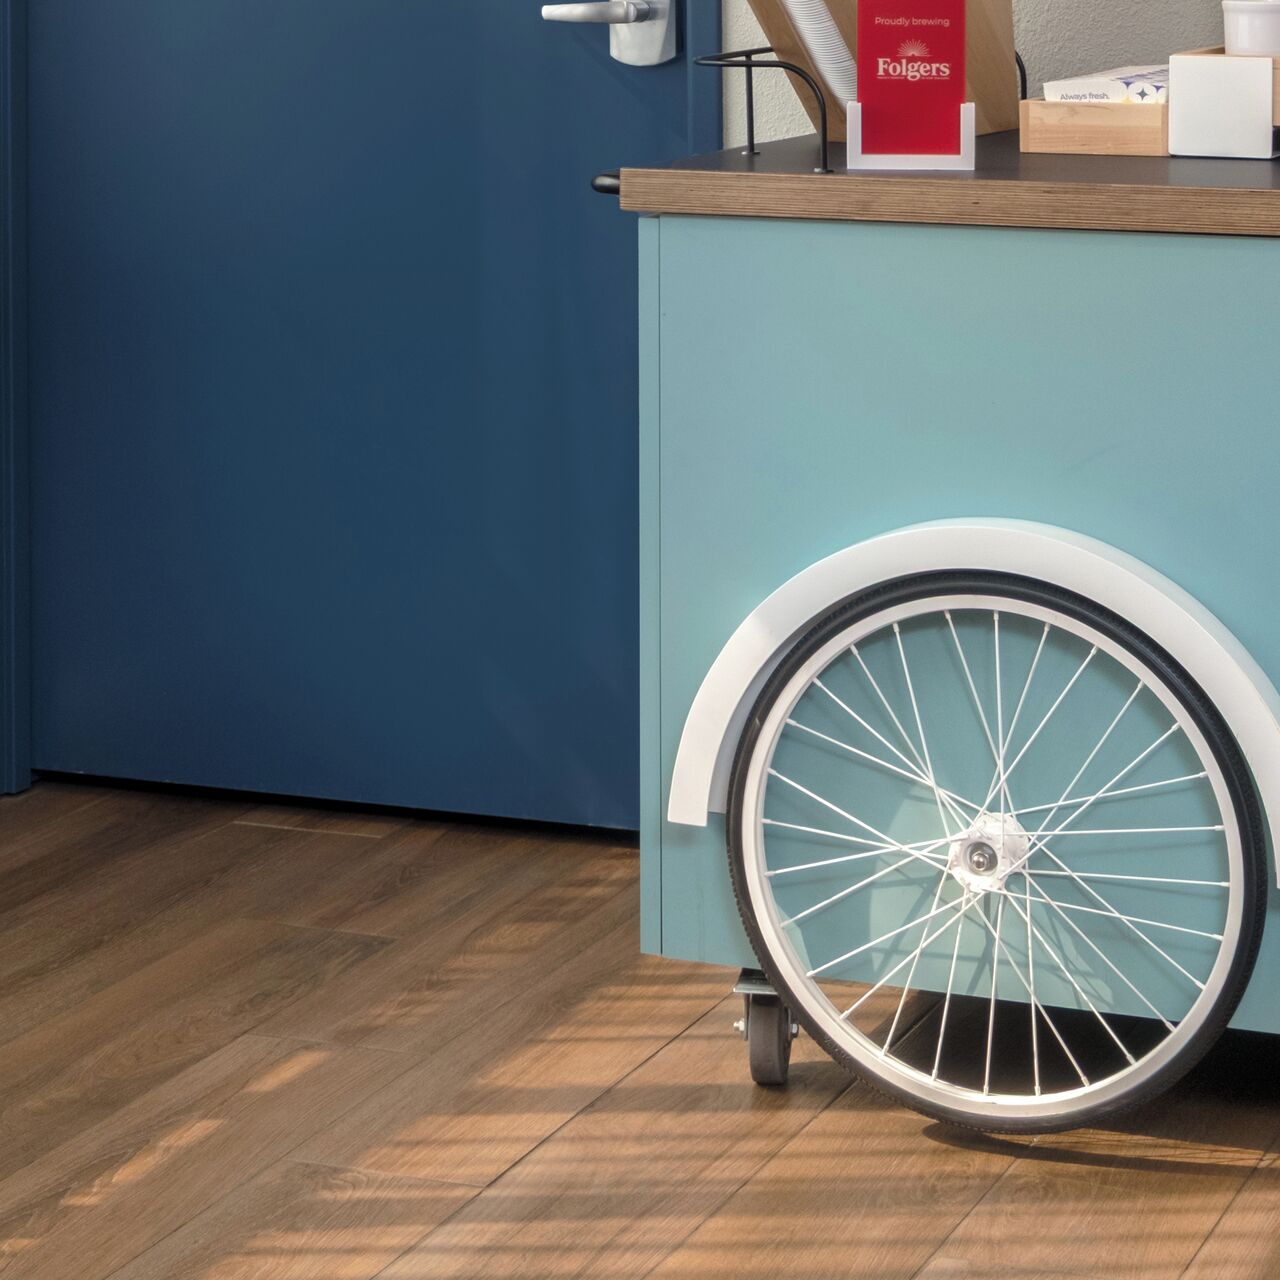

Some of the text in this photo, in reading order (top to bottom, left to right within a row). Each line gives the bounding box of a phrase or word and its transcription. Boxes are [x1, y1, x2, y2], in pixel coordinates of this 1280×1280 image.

[874, 17, 950, 27] Proudly brewing
[877, 58, 951, 81] Folgers
